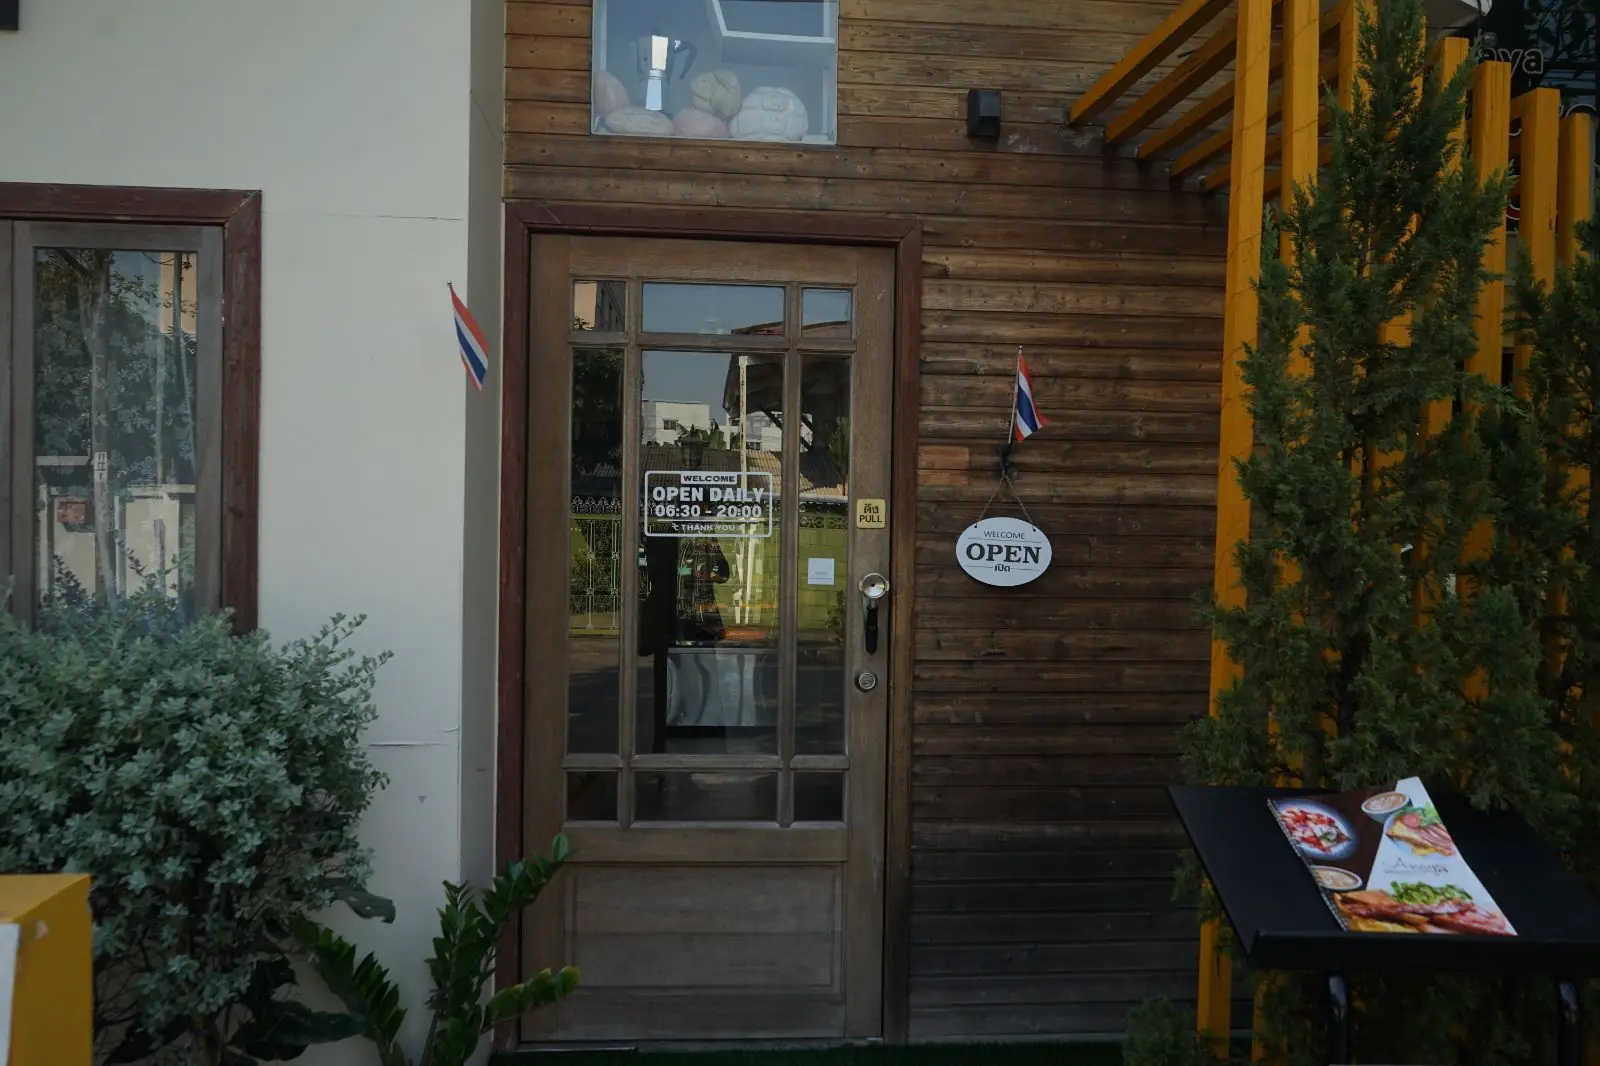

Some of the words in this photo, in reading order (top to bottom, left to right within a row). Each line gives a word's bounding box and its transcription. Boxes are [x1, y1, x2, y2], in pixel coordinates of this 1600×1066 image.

[683, 475, 735, 483] WELCOME
[652, 486, 704, 502] OPEN
[709, 487, 765, 502] DAILY
[655, 504, 700, 517] 06:30
[717, 504, 762, 518] 20:00
[863, 503, 879, 514] ดึง
[859, 514, 883, 523] PULL
[681, 523, 713, 531] THANK
[983, 530, 1025, 540] WELCOME
[965, 542, 1042, 565] OPEN
[994, 563, 1011, 573] เปิด
